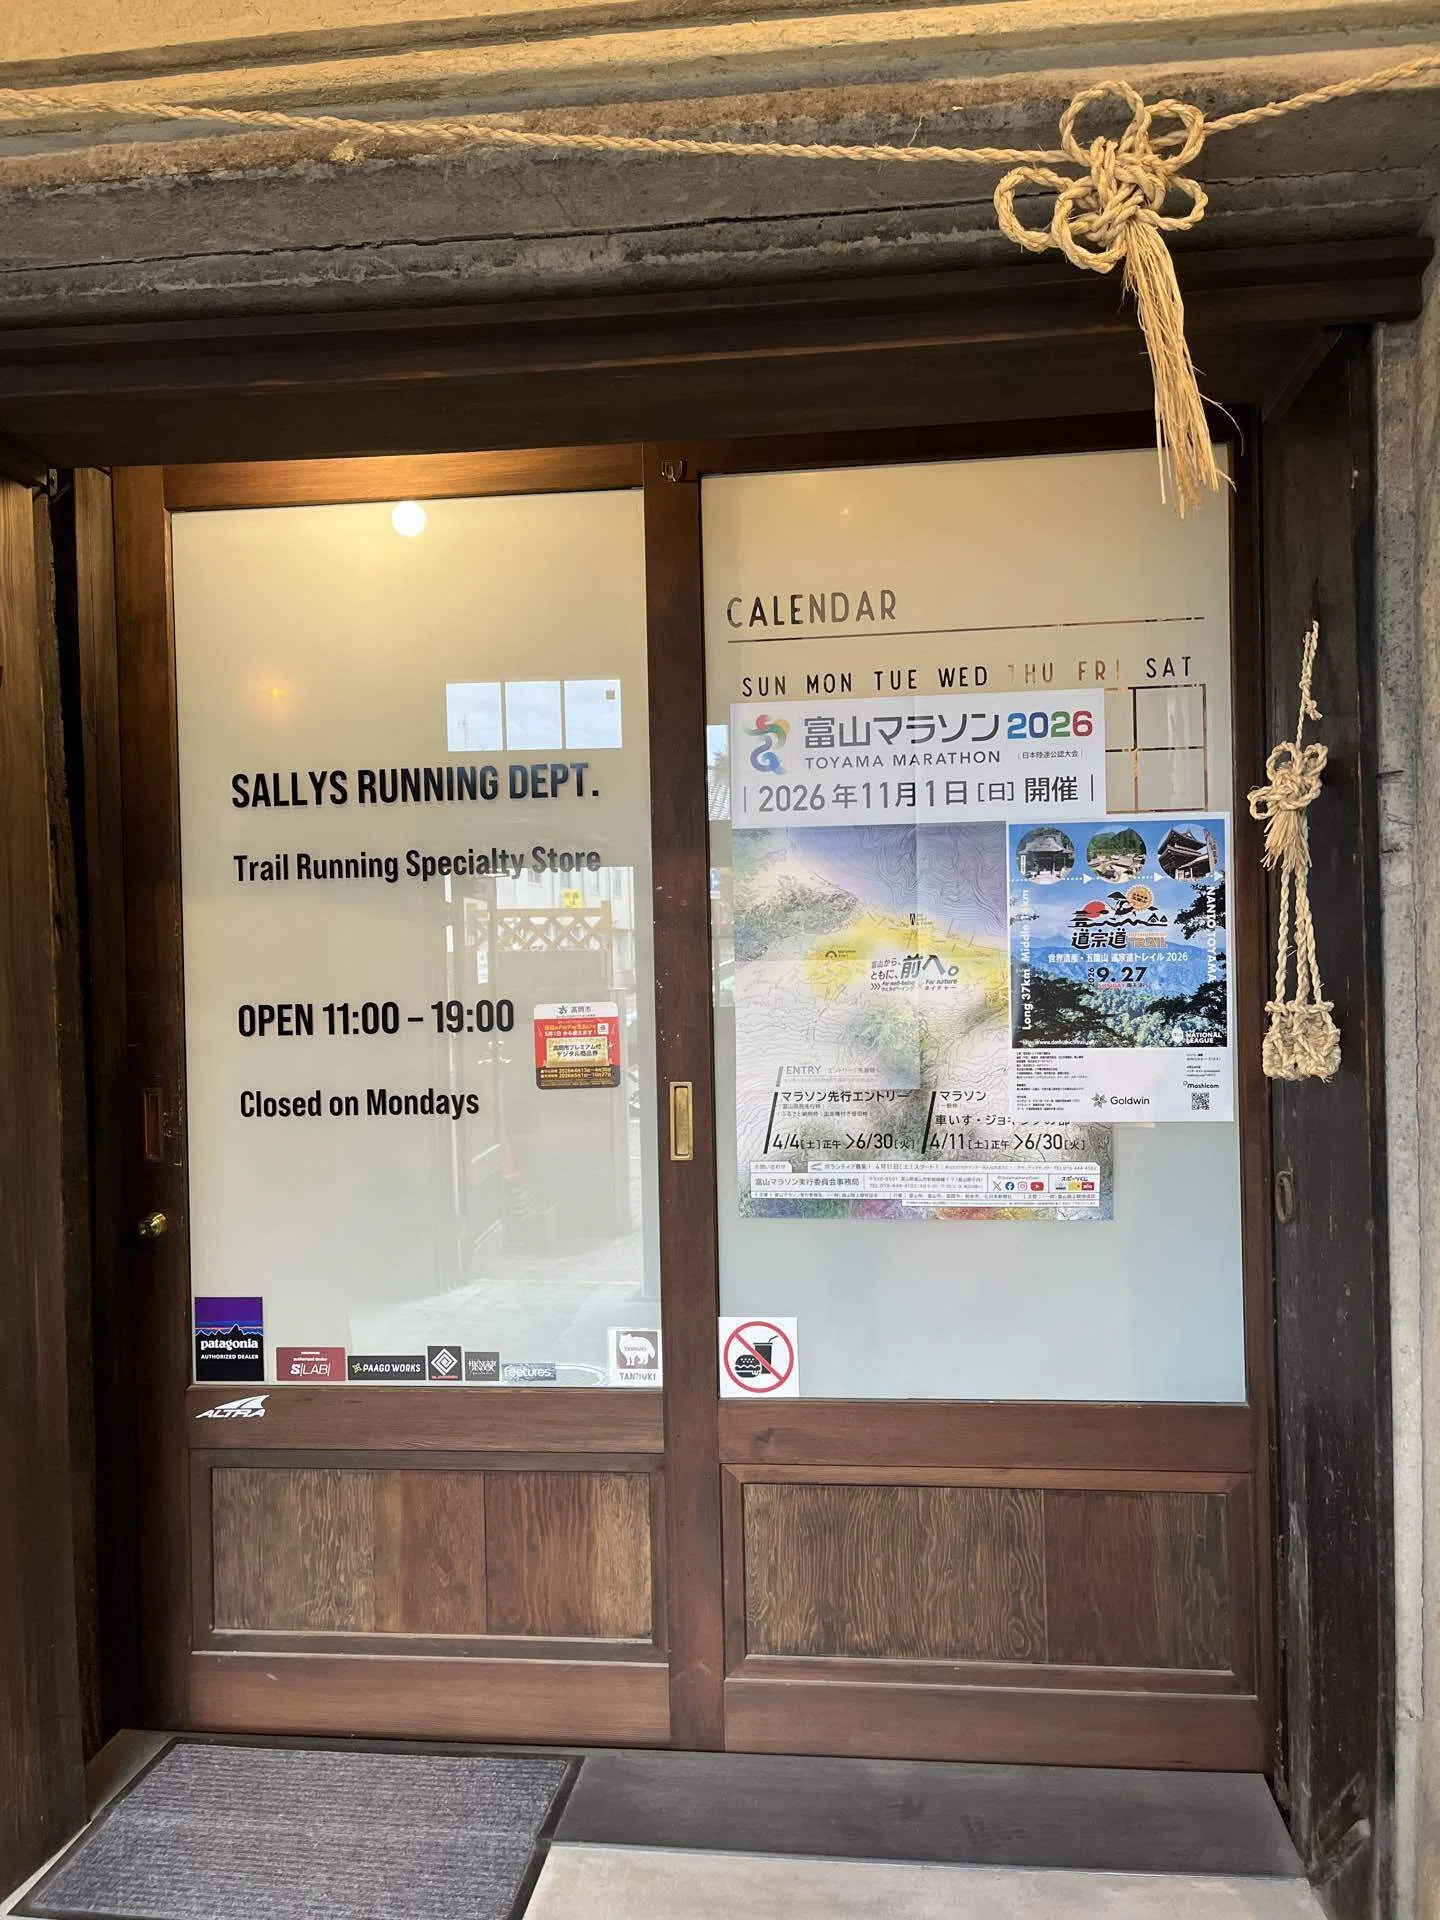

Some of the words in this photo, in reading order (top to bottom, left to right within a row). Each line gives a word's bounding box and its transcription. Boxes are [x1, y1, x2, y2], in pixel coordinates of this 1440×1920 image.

[727, 589, 896, 628] CALENDAR
[742, 676, 786, 698] SUN
[806, 671, 853, 695] MON
[874, 669, 918, 691] TUE
[938, 665, 989, 688] WED
[1078, 659, 1122, 681] FRI
[1146, 655, 1193, 678] SAT
[804, 713, 1000, 749] 富山マラソン
[1007, 710, 1093, 740] 2026
[805, 755, 884, 770] TOYAMA
[893, 750, 1001, 766] MARATHON
[231, 770, 348, 808] SALLYS
[358, 765, 499, 804] RUNNING
[509, 762, 601, 800] DEPT.
[234, 853, 289, 882] Trail
[296, 851, 399, 883] Running
[406, 847, 524, 881] Specialty
[531, 846, 602, 874] Store
[1206, 886, 1216, 928] NANTO
[1072, 928, 1127, 949] 道宗道
[901, 953, 960, 980] 前へ。
[1167, 952, 1188, 961] 2026
[1206, 932, 1217, 983] TOYAMA
[1021, 969, 1031, 1000] 37km
[238, 1004, 314, 1037] OPEN
[322, 1002, 400, 1036] 11:00
[431, 999, 515, 1034] 19:00
[1022, 1002, 1033, 1030] Long
[786, 1065, 822, 1075] ENTRY
[240, 1090, 323, 1119] Closed
[328, 1096, 360, 1117] on
[366, 1088, 480, 1121] Mondays
[781, 1090, 909, 1102] マラソン先行エントリー
[940, 1091, 987, 1102] マラソン
[1110, 1096, 1150, 1105] Goldwin
[200, 1337, 259, 1351] patagonia
[363, 1364, 389, 1373] PAAGO
[391, 1363, 421, 1373] WORKS
[503, 1365, 551, 1377] feetures
[195, 1408, 266, 1419] ALTRA
